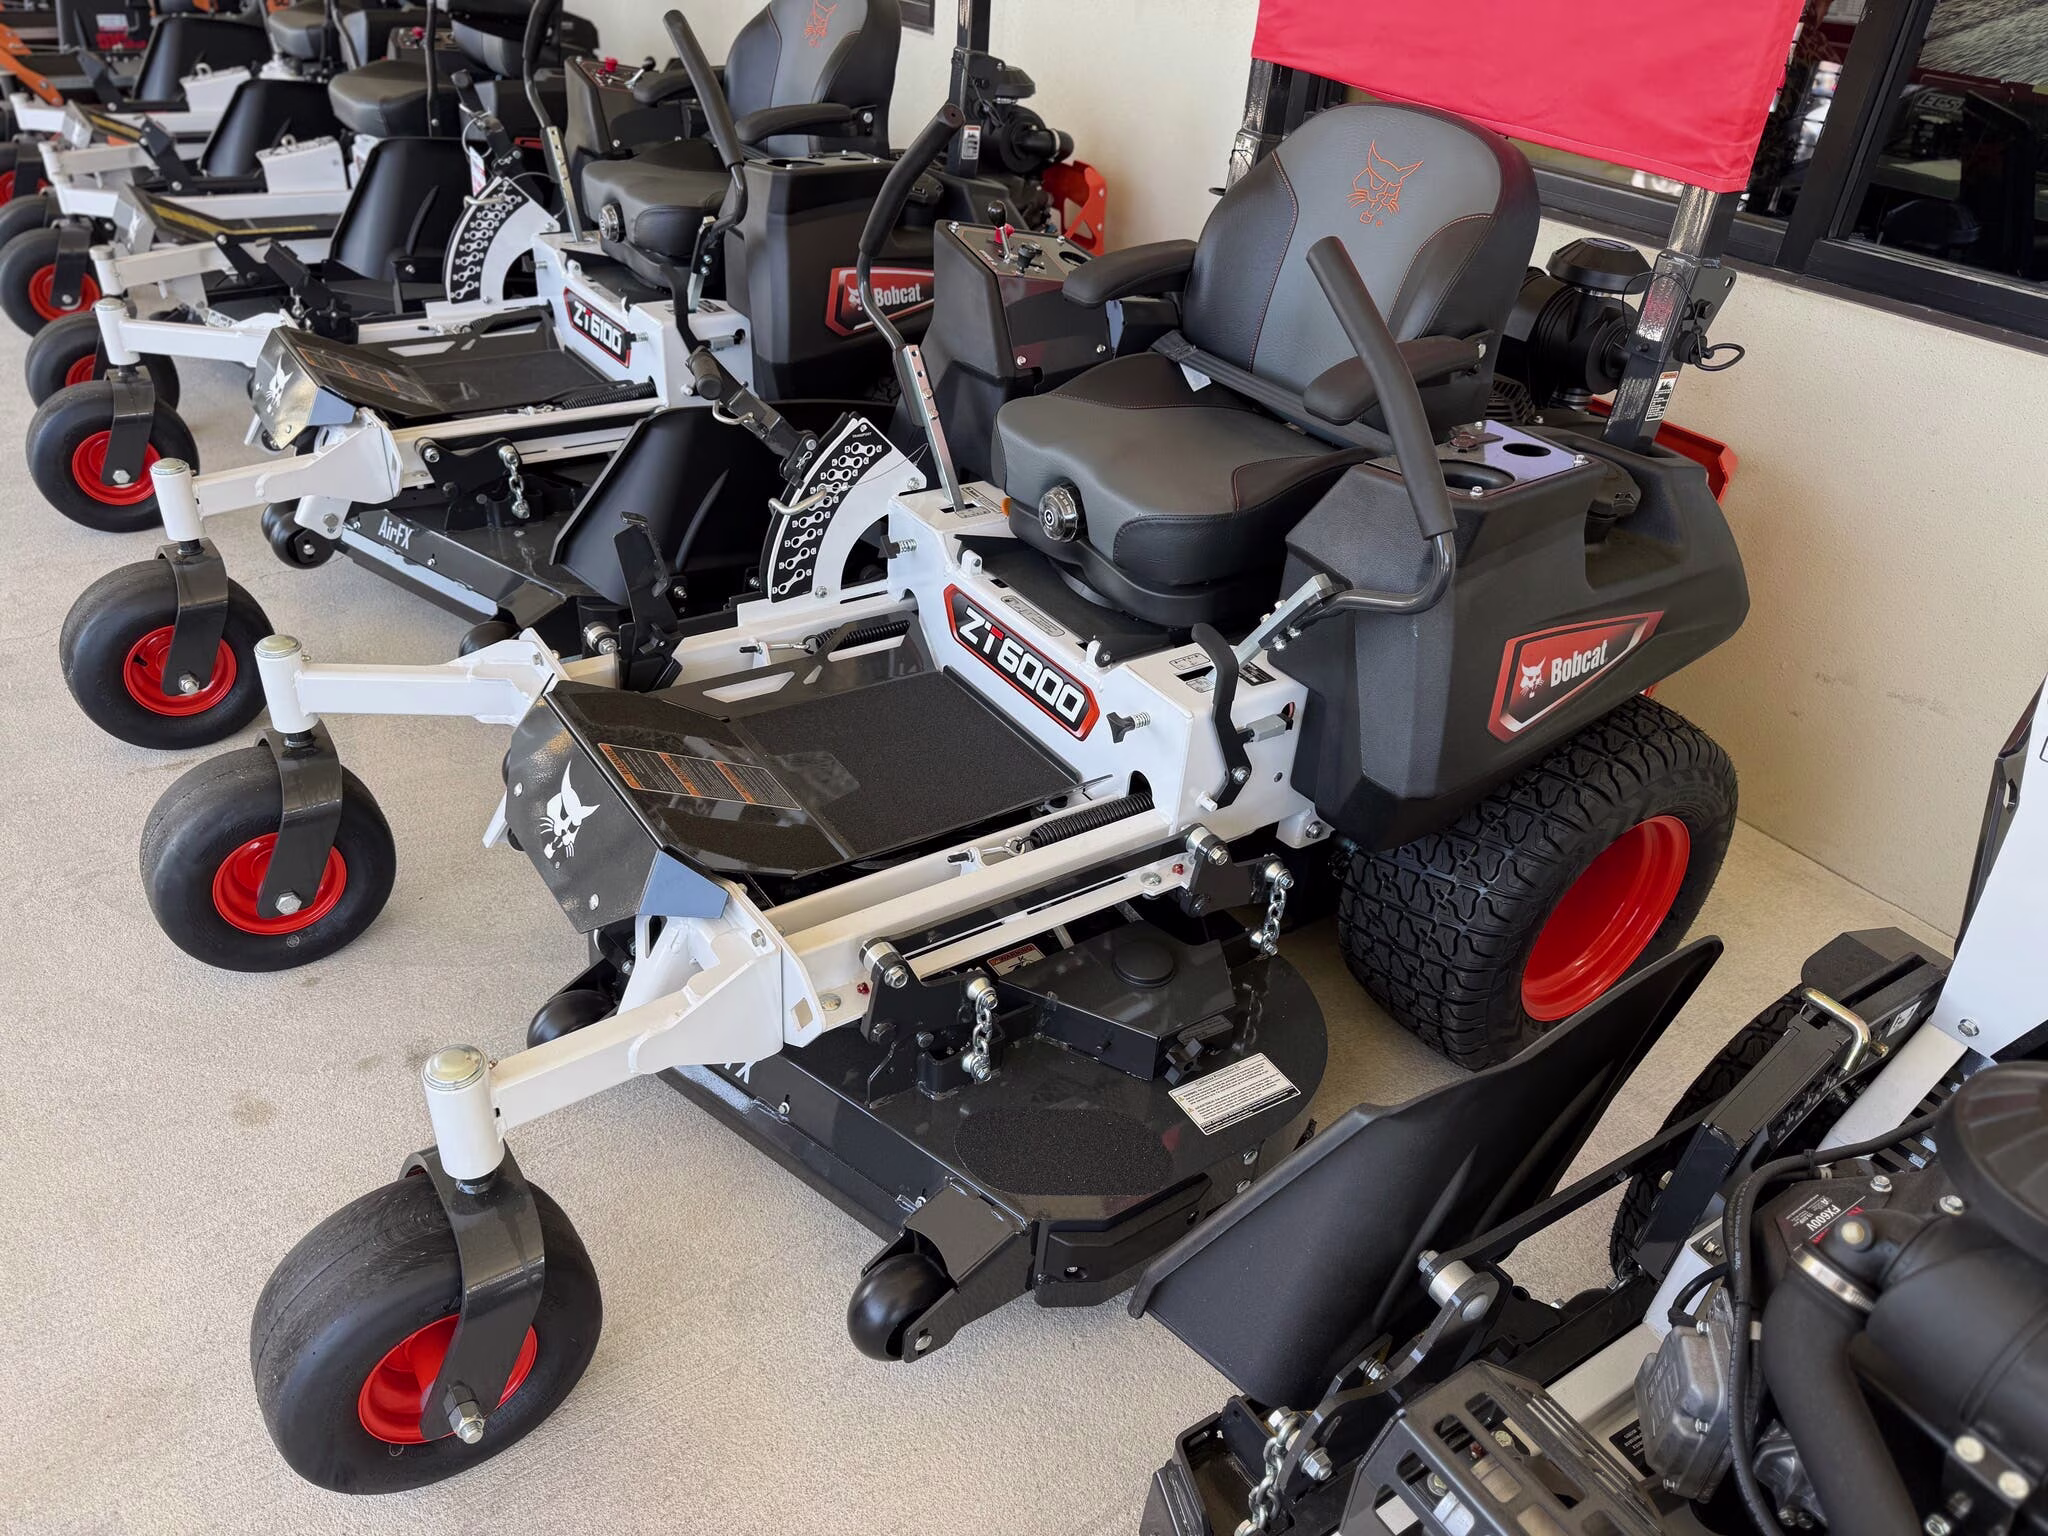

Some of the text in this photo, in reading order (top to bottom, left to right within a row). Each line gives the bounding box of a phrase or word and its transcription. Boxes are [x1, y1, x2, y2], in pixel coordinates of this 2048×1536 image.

[873, 283, 921, 307] Bobcat
[378, 516, 415, 550] AirFX
[959, 606, 1086, 723] ZT6000
[1551, 639, 1608, 688] Bobcat
[1806, 1204, 1841, 1232] FX600V
